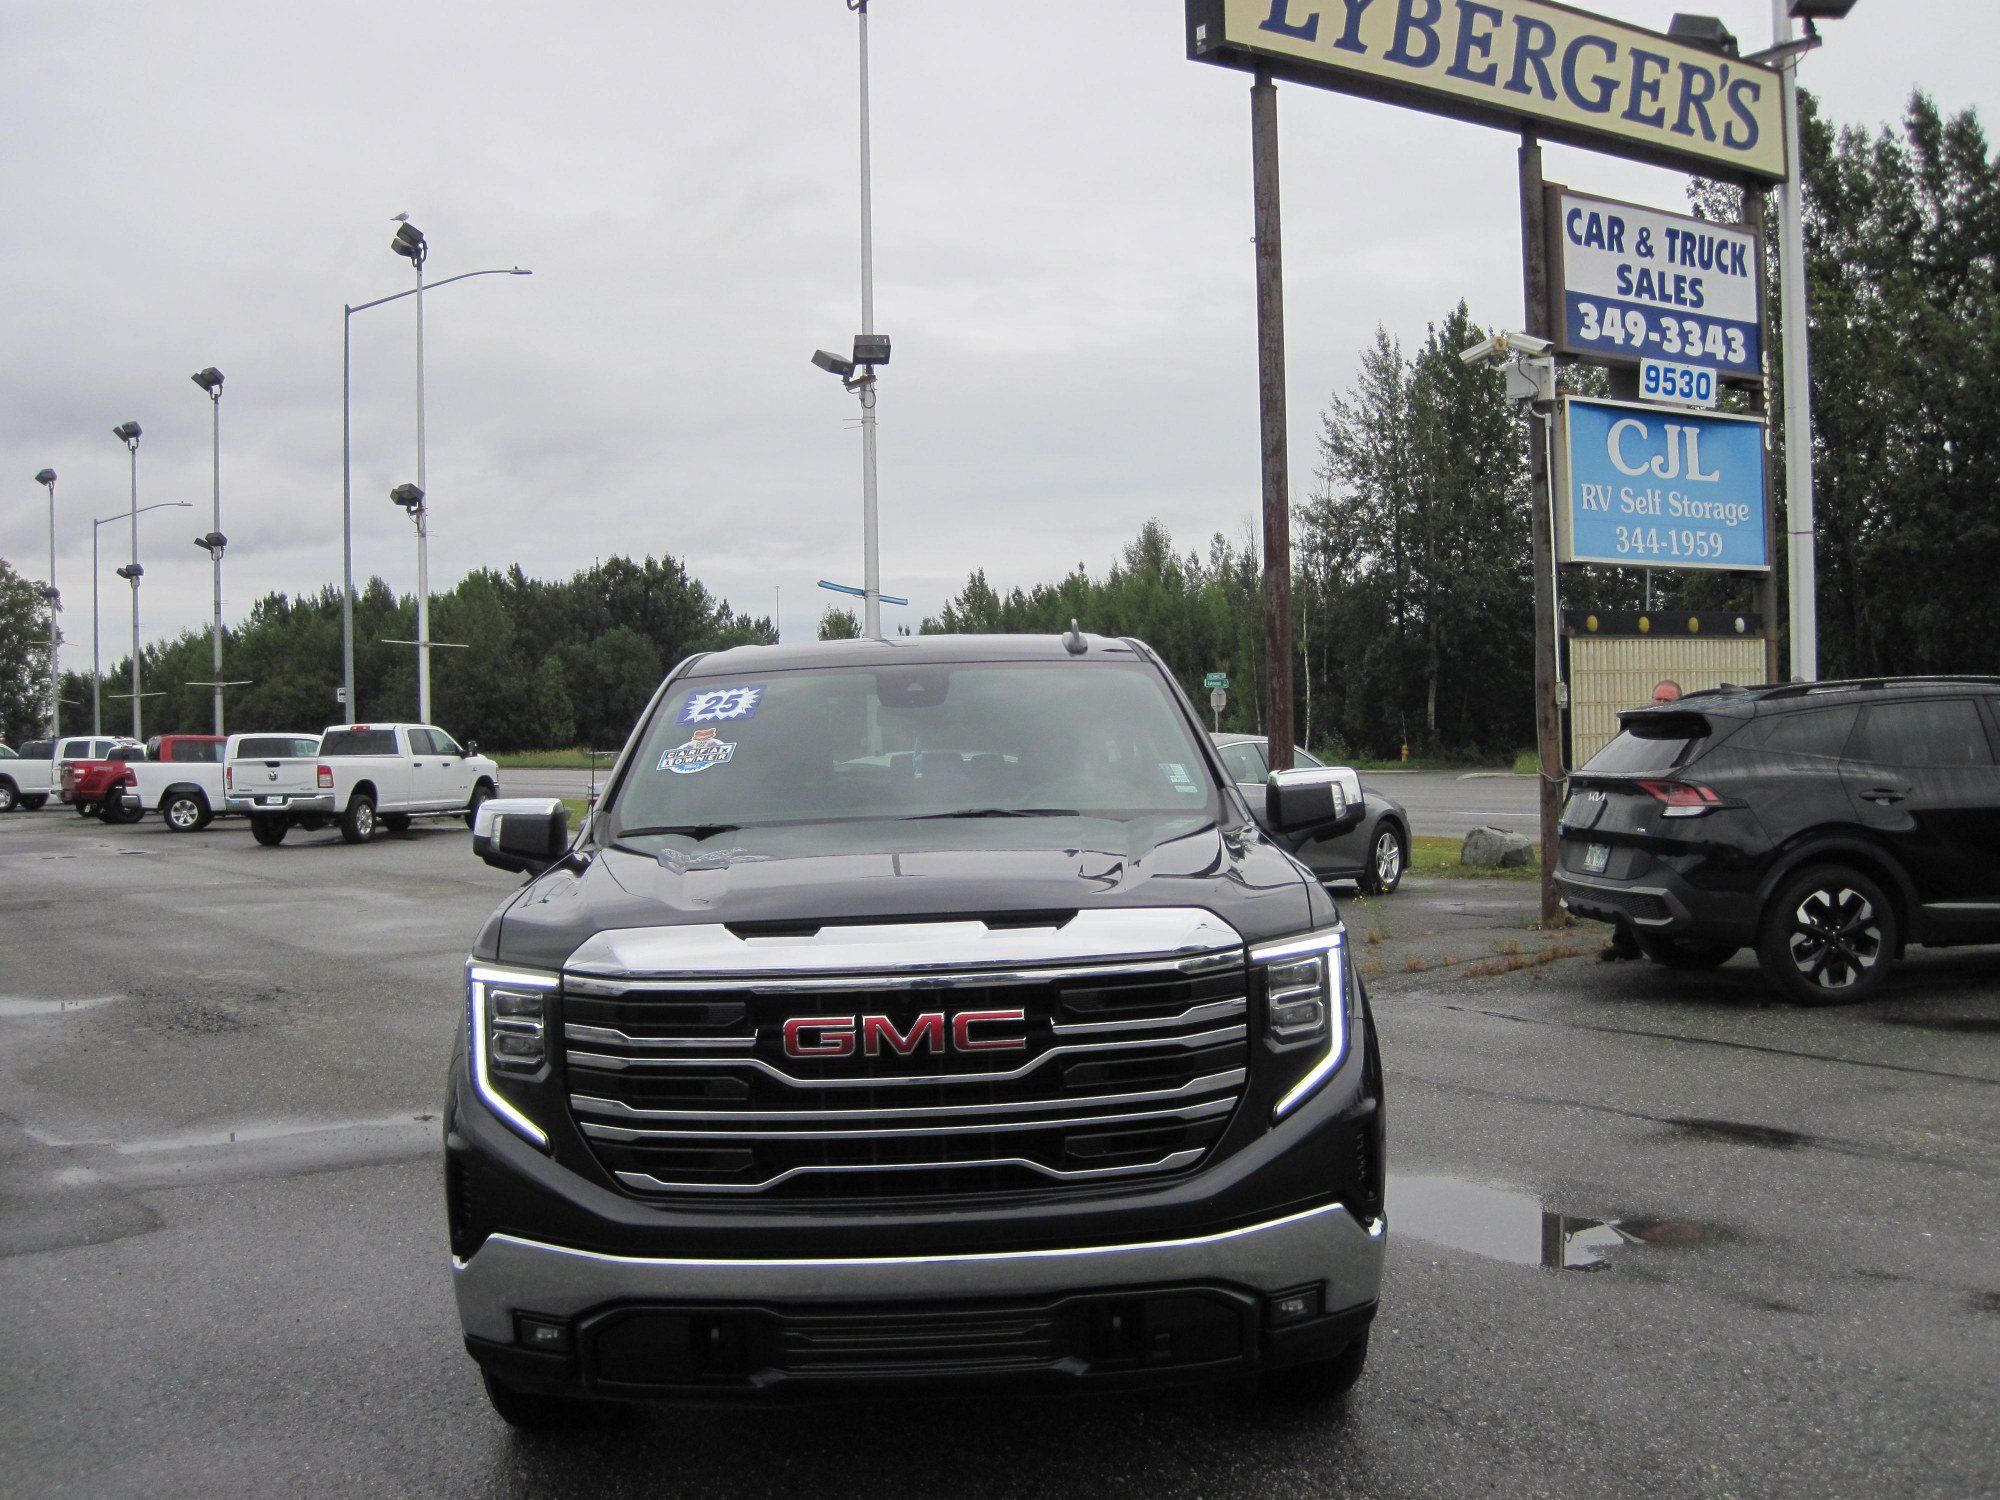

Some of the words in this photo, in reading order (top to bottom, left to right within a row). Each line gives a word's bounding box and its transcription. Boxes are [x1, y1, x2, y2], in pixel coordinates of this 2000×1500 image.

[1257, 0, 1761, 151] LYBERGER'S
[1566, 207, 1625, 253] CAR
[1635, 226, 1654, 259] &
[1664, 227, 1747, 277] TRUCK
[1616, 263, 1705, 309] SALES
[1577, 302, 1746, 364] 349-3343
[1644, 364, 1711, 400] 9530
[1606, 418, 1720, 483] CJL
[1581, 483, 1612, 512] RV
[1620, 486, 1661, 516] Self
[1668, 491, 1750, 526] Storage
[1616, 525, 1723, 557] 344-1959
[697, 693, 743, 715] 25
[666, 746, 730, 759] CARFAX
[782, 1008, 1026, 1058] GMC
